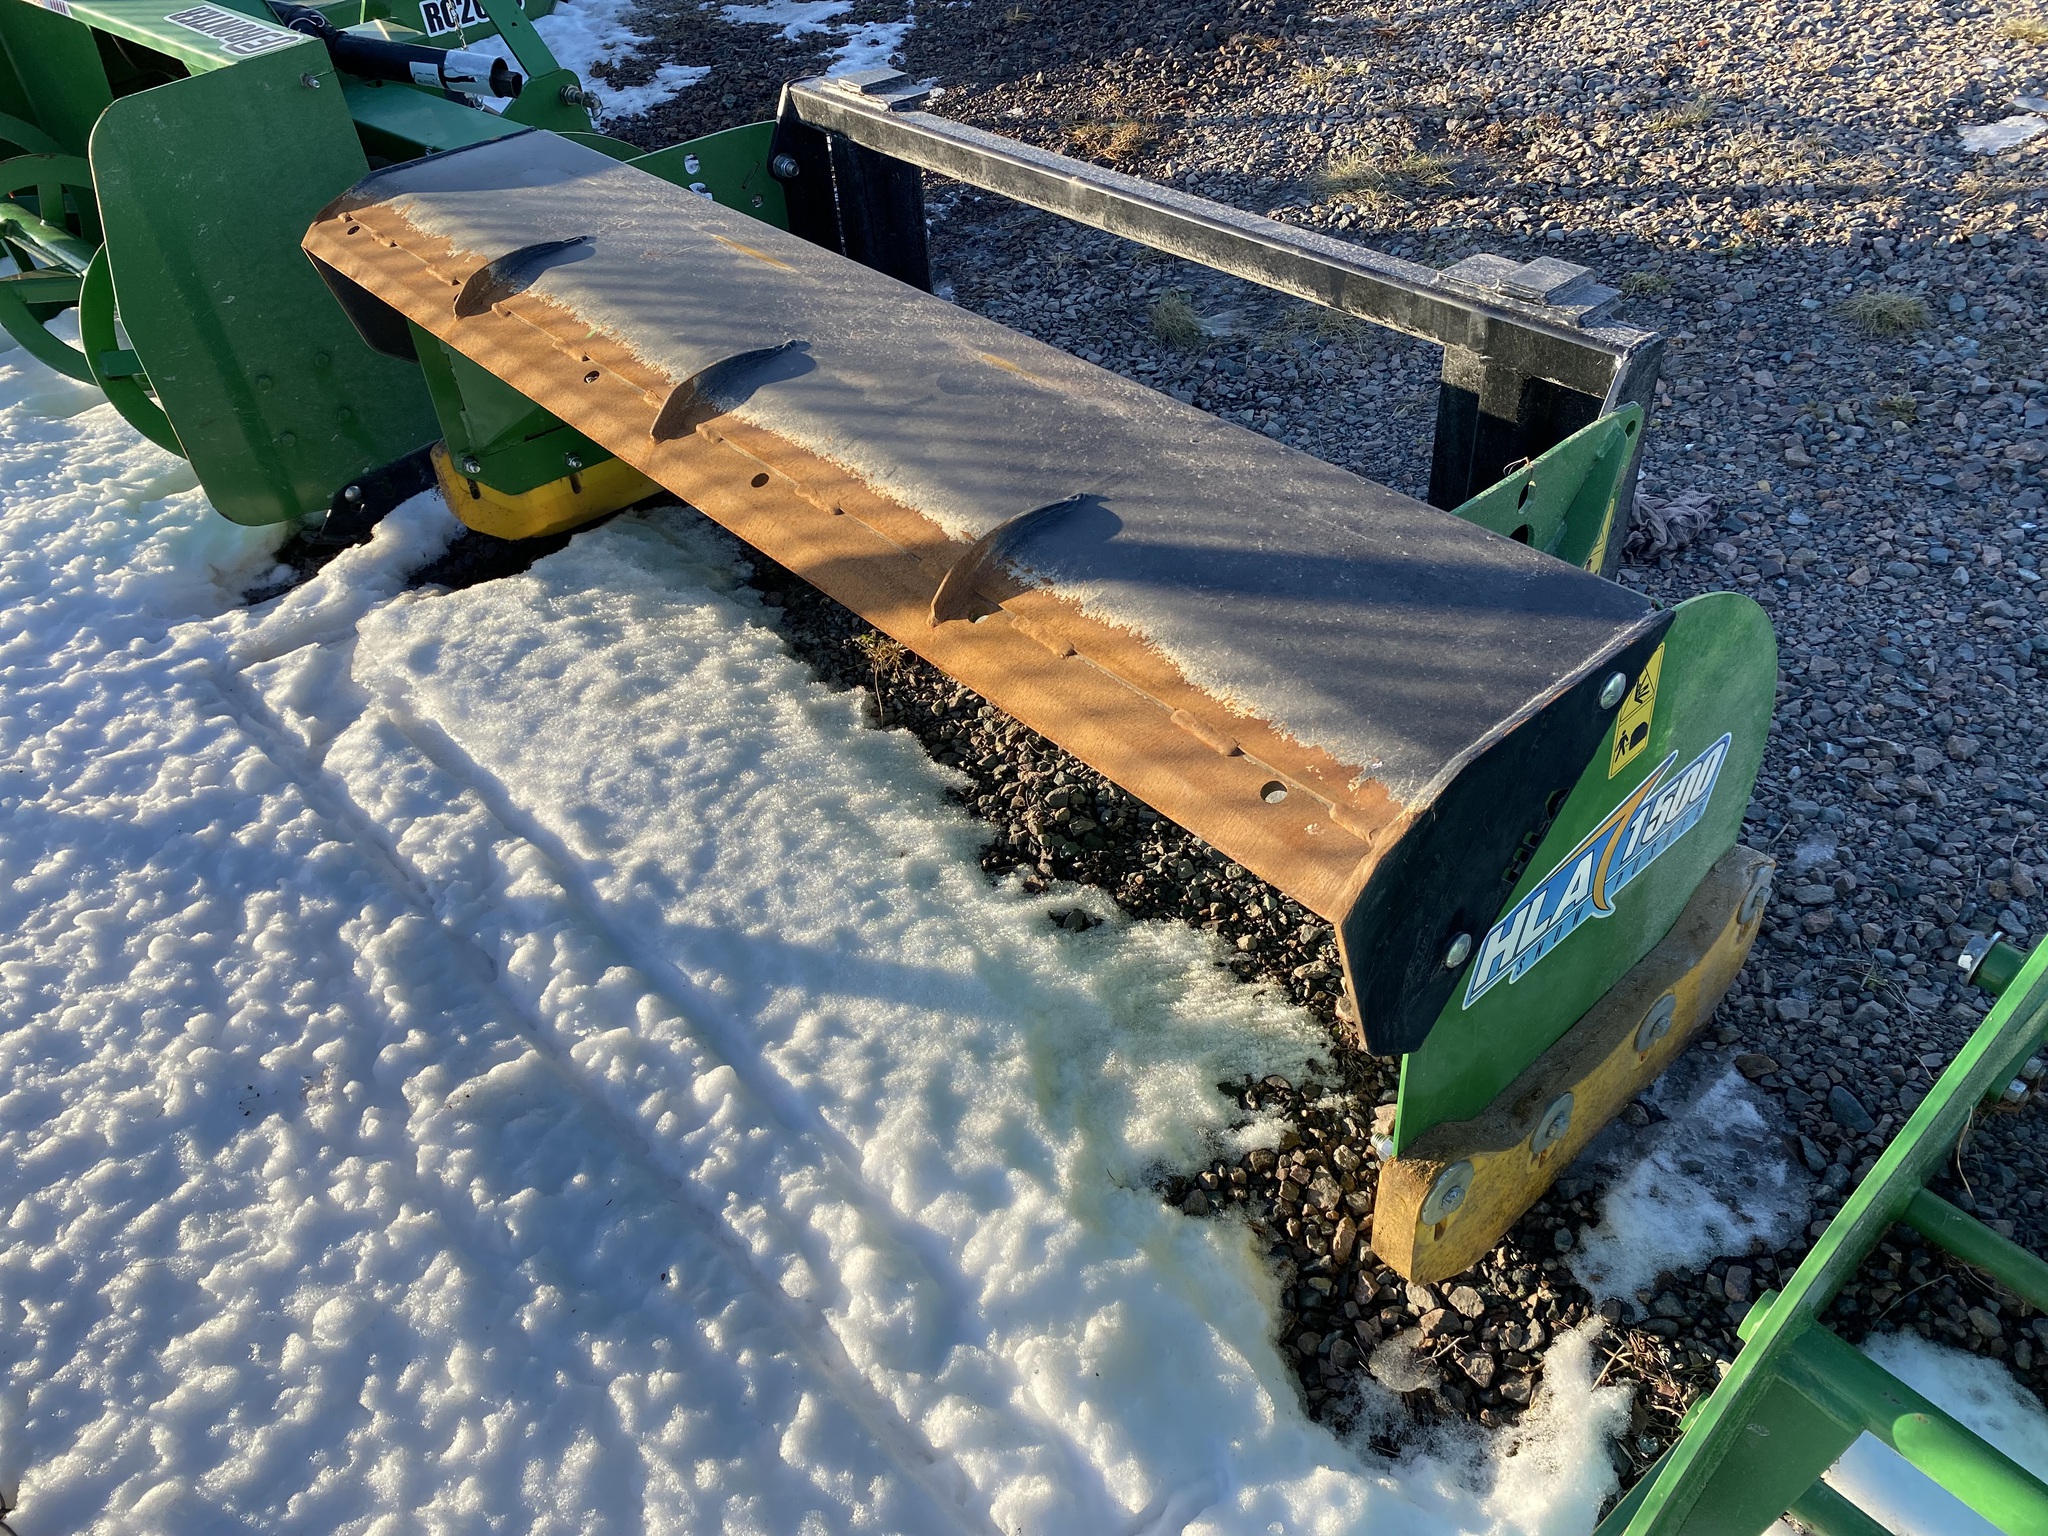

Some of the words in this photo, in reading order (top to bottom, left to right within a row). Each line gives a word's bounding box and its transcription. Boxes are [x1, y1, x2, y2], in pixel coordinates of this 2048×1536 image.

[168, 6, 299, 54] FRONTIER
[1473, 850, 1594, 992] HLA
[1621, 742, 1726, 862] 1500
[1516, 907, 1584, 976] SNOW
